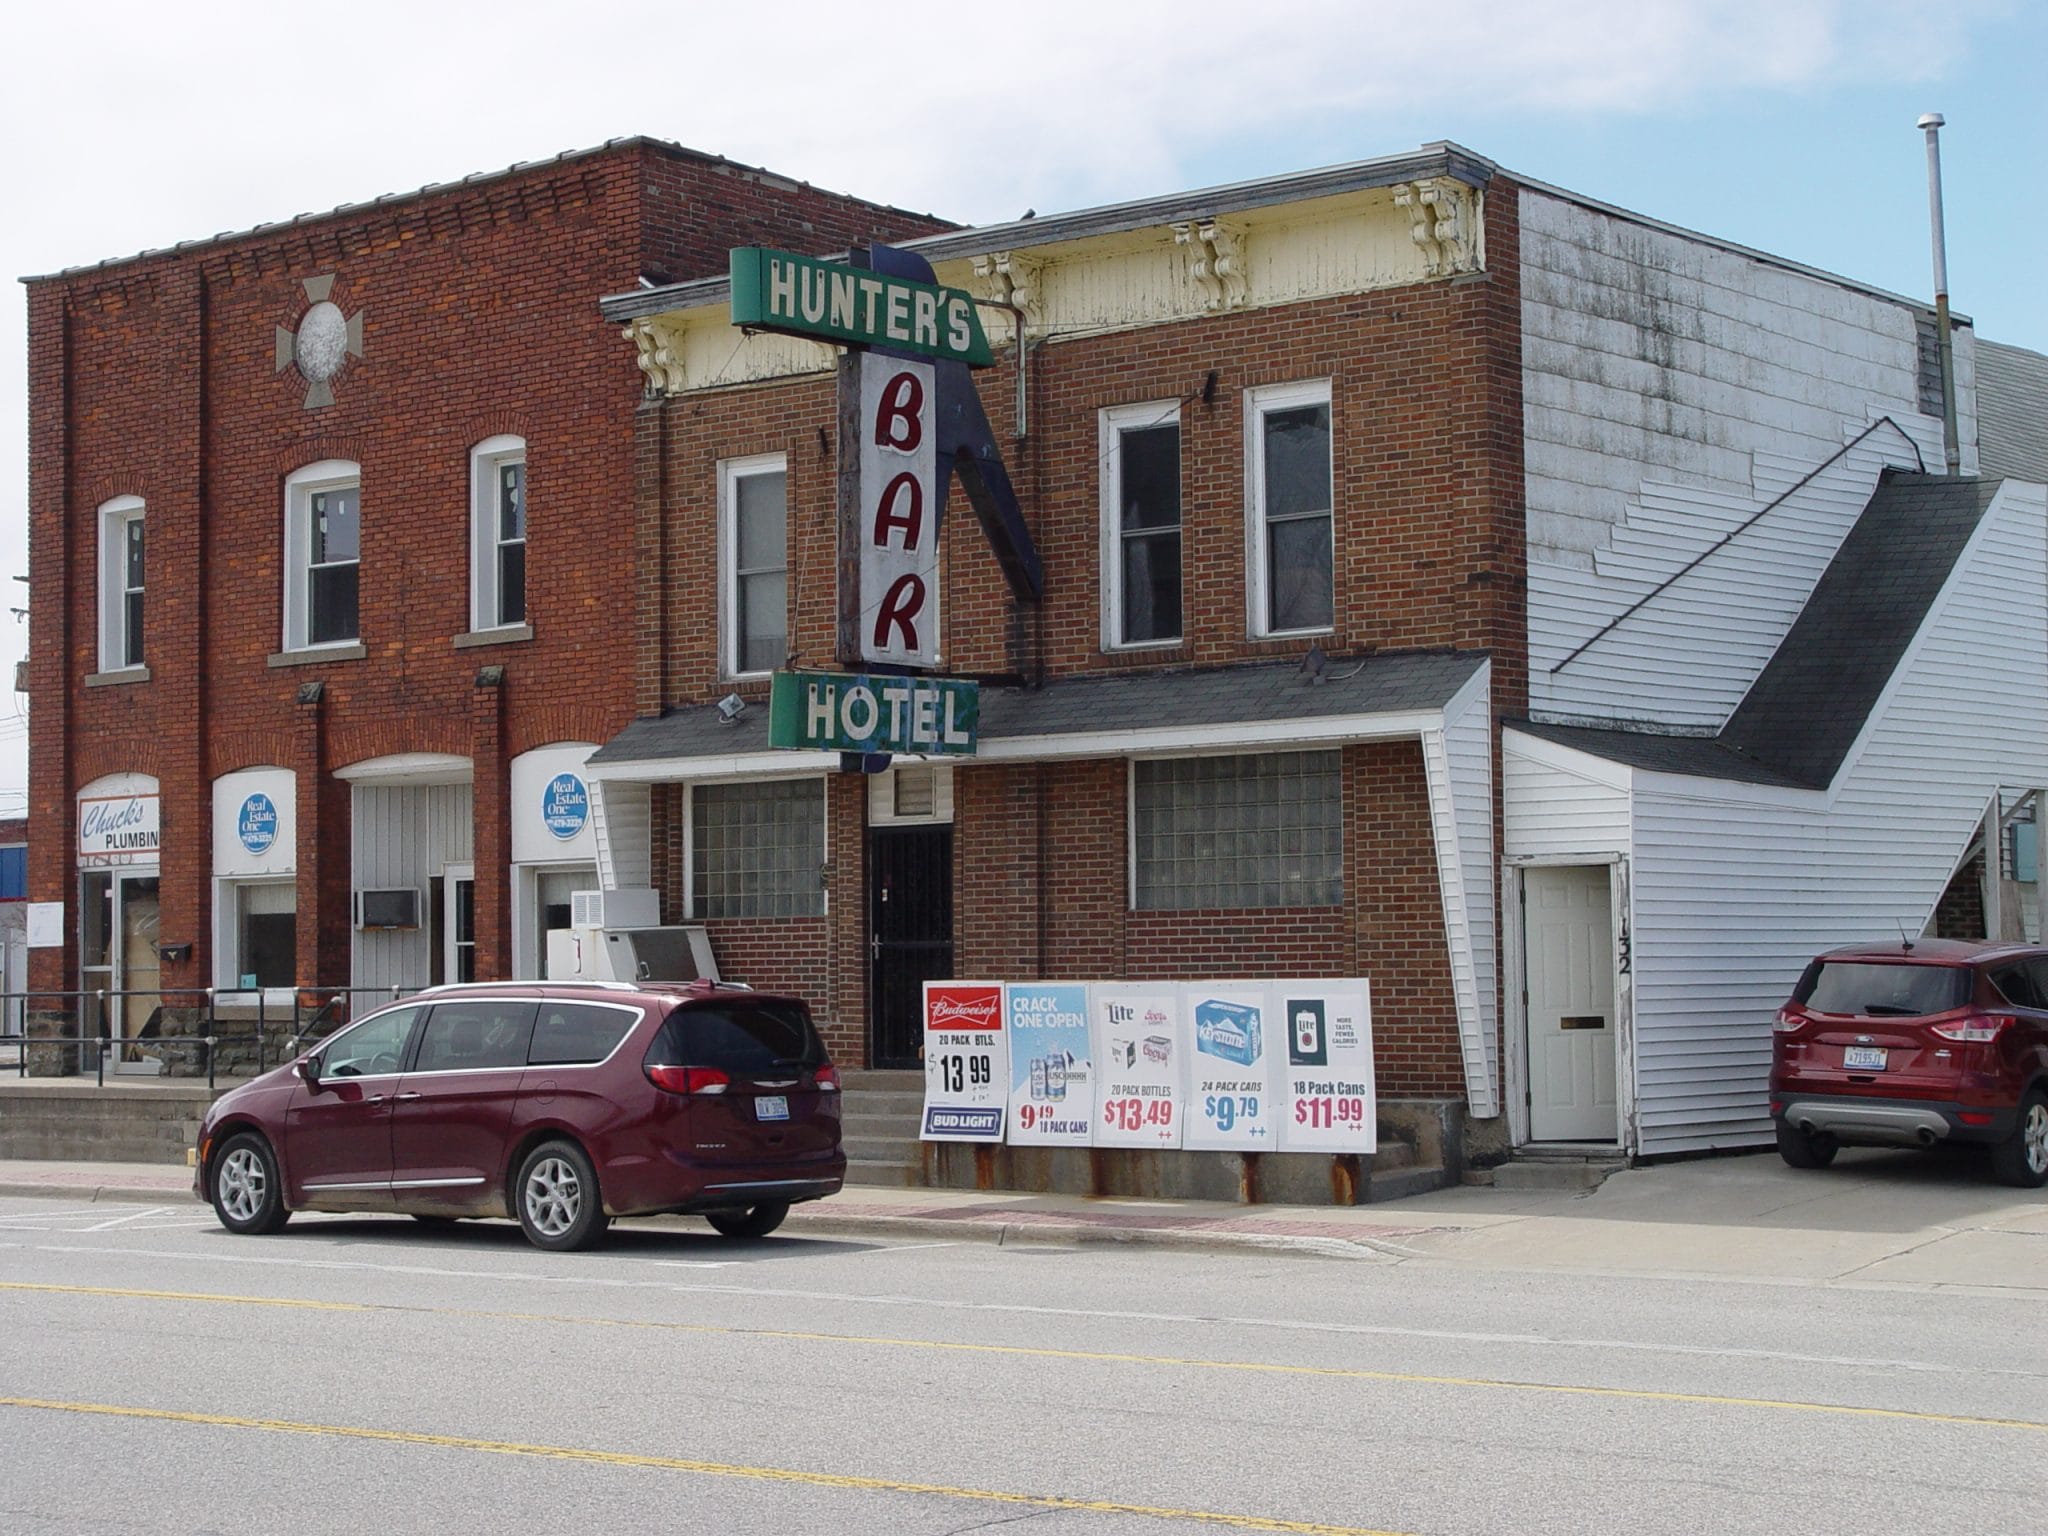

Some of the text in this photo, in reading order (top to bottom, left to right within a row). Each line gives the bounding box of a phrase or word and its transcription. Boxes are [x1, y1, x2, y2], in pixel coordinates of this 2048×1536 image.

[770, 258, 971, 353] HUNTER'S
[874, 371, 927, 656] BAR
[807, 683, 969, 745] HOTEL
[552, 779, 575, 793] Real
[247, 799, 266, 811] Real
[556, 792, 586, 805] Estate
[547, 803, 568, 815] One
[83, 798, 145, 839] Chuck's
[250, 811, 275, 822] Estate
[242, 821, 260, 832] One
[929, 1000, 998, 1018] Budweiser
[1013, 997, 1058, 1013] CRACK
[1014, 1013, 1085, 1029] ONE OPEN
[1108, 1004, 1135, 1025] Lite
[1298, 1020, 1315, 1032] Lite
[938, 1035, 996, 1046] 20 PACK BTLS.
[940, 1055, 964, 1093] 13
[969, 1055, 991, 1084] 99
[1111, 1085, 1172, 1097] 20 PACK BOTTLES
[1201, 1081, 1213, 1092] 24
[1216, 1081, 1238, 1092] PACK
[1293, 1081, 1366, 1095] 18 Pack Cans
[1104, 1098, 1173, 1131] $13.49
[1205, 1095, 1258, 1131] $9.79
[1295, 1097, 1363, 1129] $11.99
[933, 1115, 995, 1128] BUD LIGHT
[1039, 1121, 1088, 1134] 18 PACK CANS
